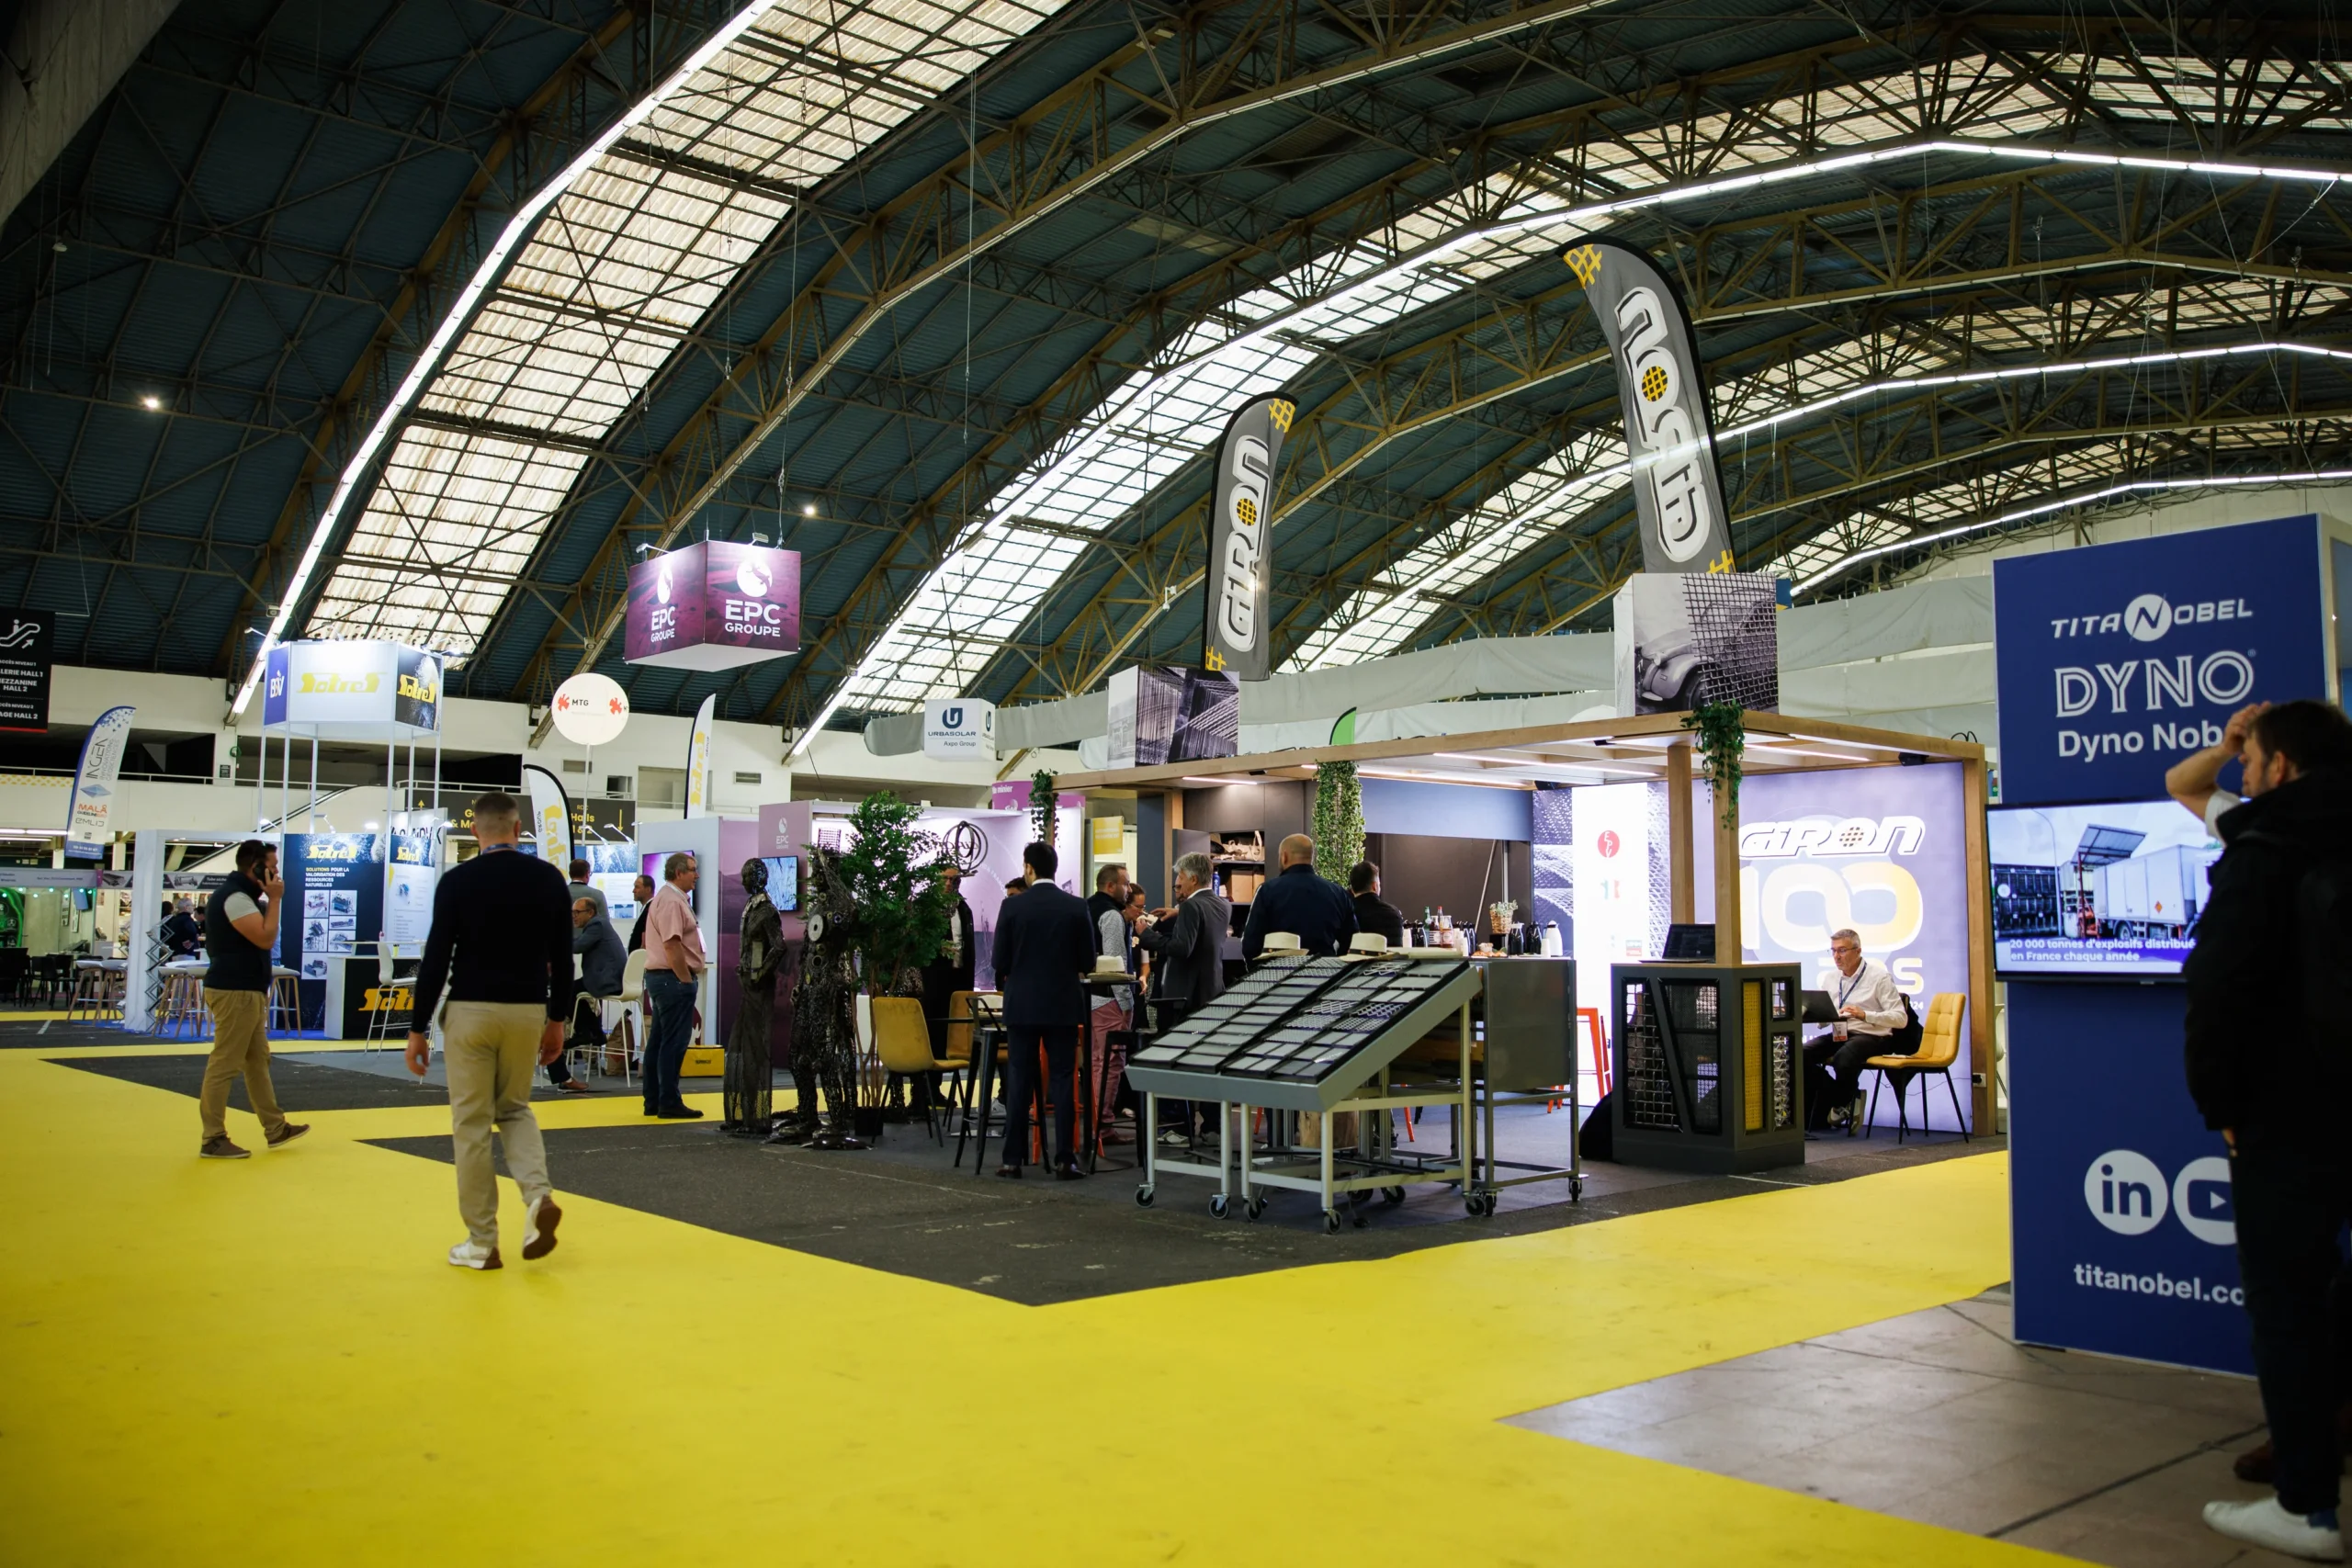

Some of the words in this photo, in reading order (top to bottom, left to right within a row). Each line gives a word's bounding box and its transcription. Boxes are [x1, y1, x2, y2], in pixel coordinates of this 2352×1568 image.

[651, 606, 675, 631] EPC
[725, 599, 781, 625] EPC
[2051, 593, 2253, 642] TITANOBEL
[650, 628, 675, 643] GROUPE
[725, 622, 781, 637] GROUPE
[2054, 650, 2254, 717] DYNO
[2058, 730, 2143, 762] Dyno
[2153, 720, 2223, 750] Nob
[571, 813, 594, 822] Hals
[2010, 940, 2022, 949] 20
[2025, 940, 2044, 949] 000
[2047, 940, 2083, 949] tonnes
[2086, 939, 2143, 951] d'explosifs
[2145, 938, 2196, 949] distribué
[2027, 952, 2061, 961] France
[2064, 952, 2103, 963] chaque
[2106, 952, 2140, 961] année
[2074, 1264, 2245, 1306] titanobel.co
